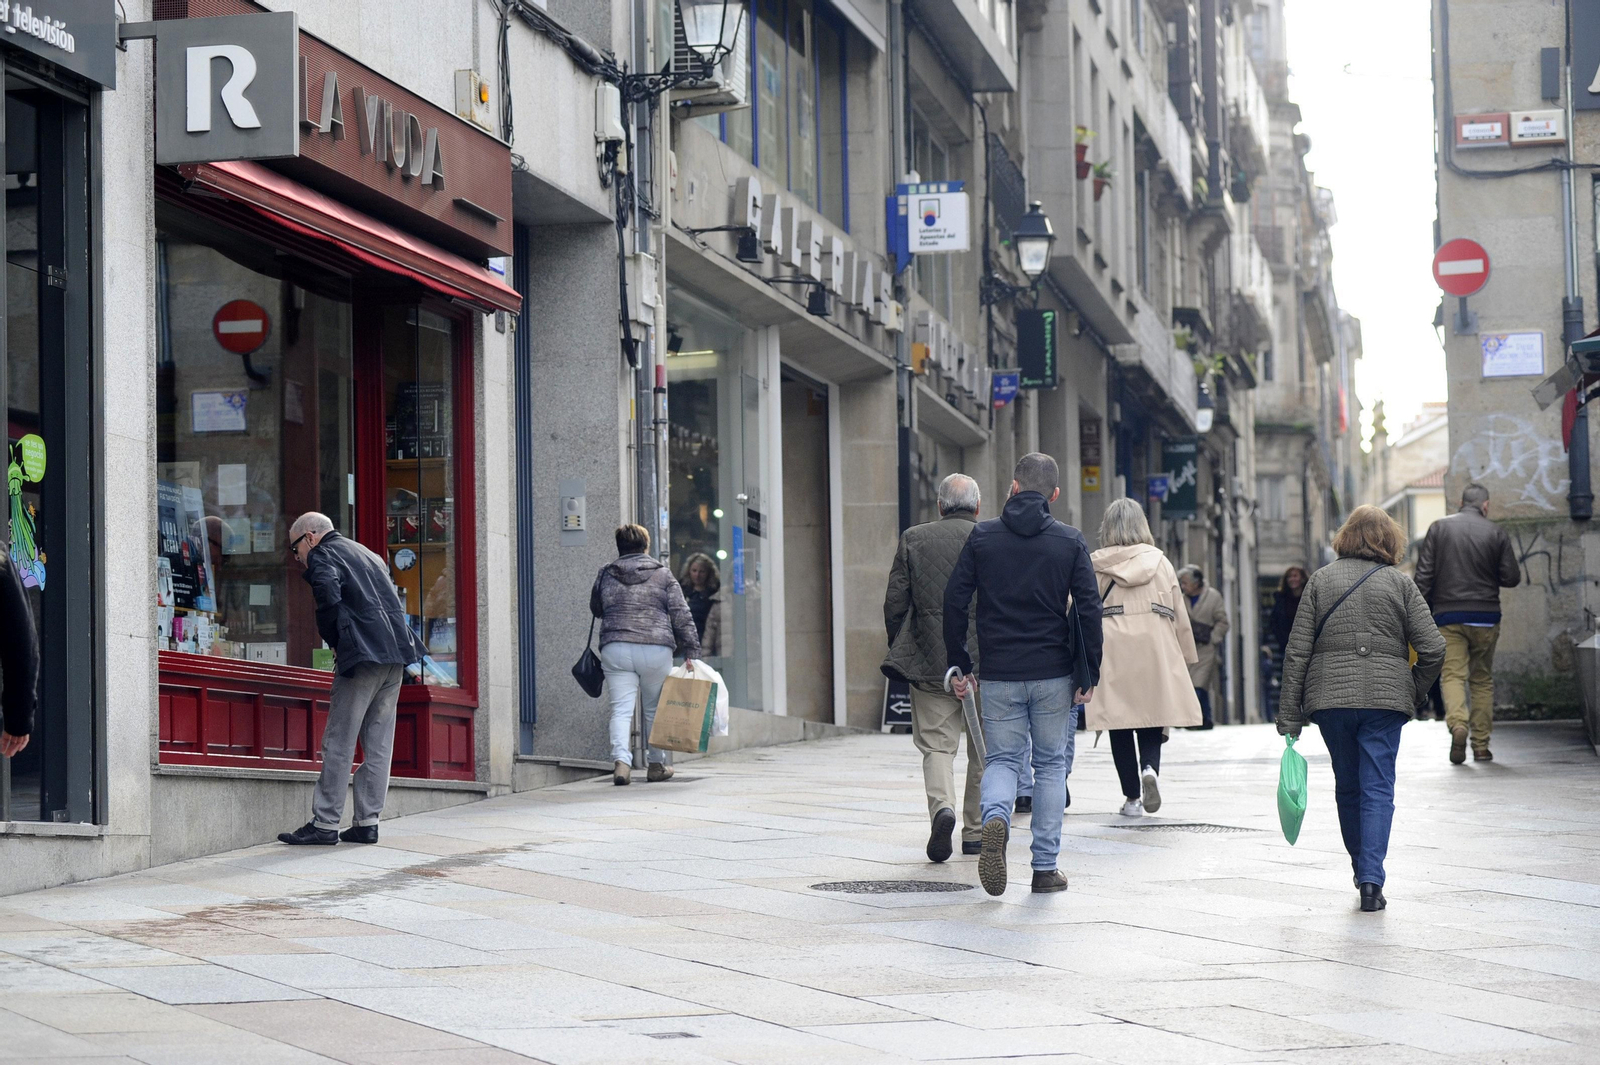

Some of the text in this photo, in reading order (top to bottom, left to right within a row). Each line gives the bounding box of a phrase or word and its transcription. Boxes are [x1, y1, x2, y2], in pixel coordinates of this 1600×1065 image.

[187, 45, 262, 132] R
[299, 55, 446, 191] LA VIUDA
